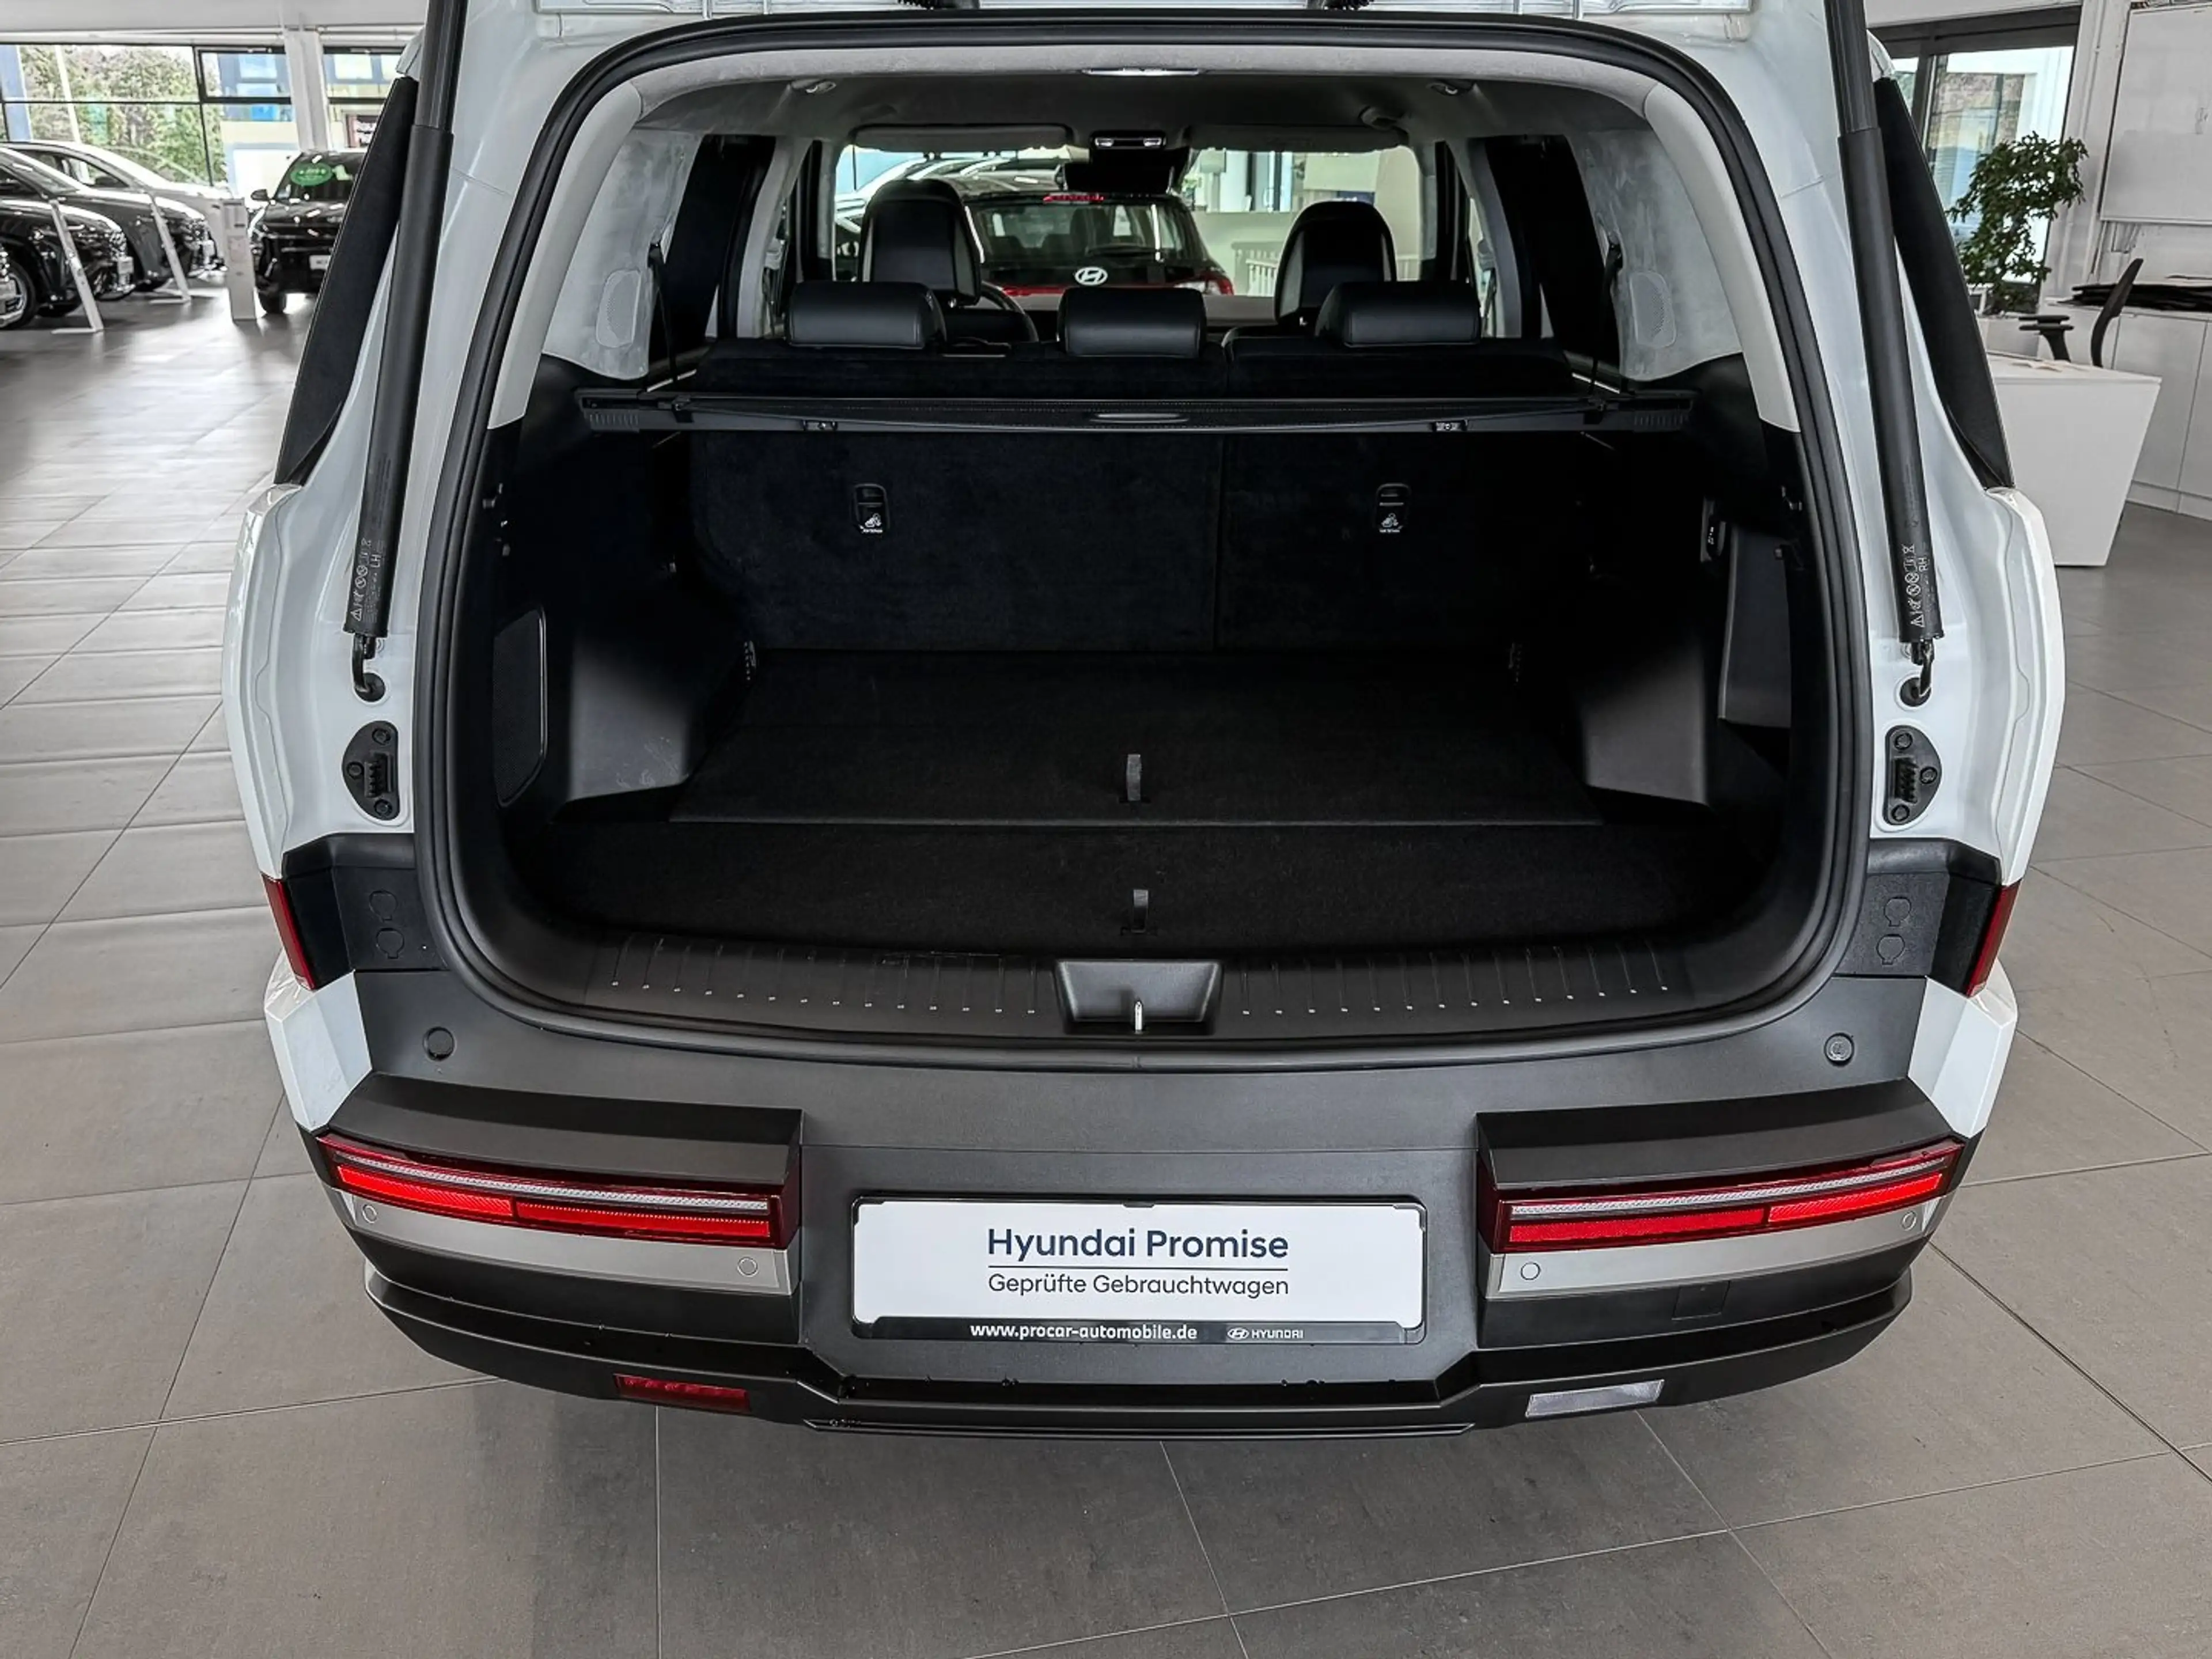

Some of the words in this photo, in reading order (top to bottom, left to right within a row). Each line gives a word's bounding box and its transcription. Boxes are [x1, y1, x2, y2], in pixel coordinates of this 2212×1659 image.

[988, 1228, 1135, 1262] Hyundai
[1147, 1229, 1289, 1259] Promise
[988, 1273, 1086, 1296] Geprüfte
[1093, 1274, 1289, 1299] Gebrauchtwagen
[970, 1324, 1197, 1340] www.procar-automobile.de
[1252, 1330, 1304, 1339] HYUNDAI
